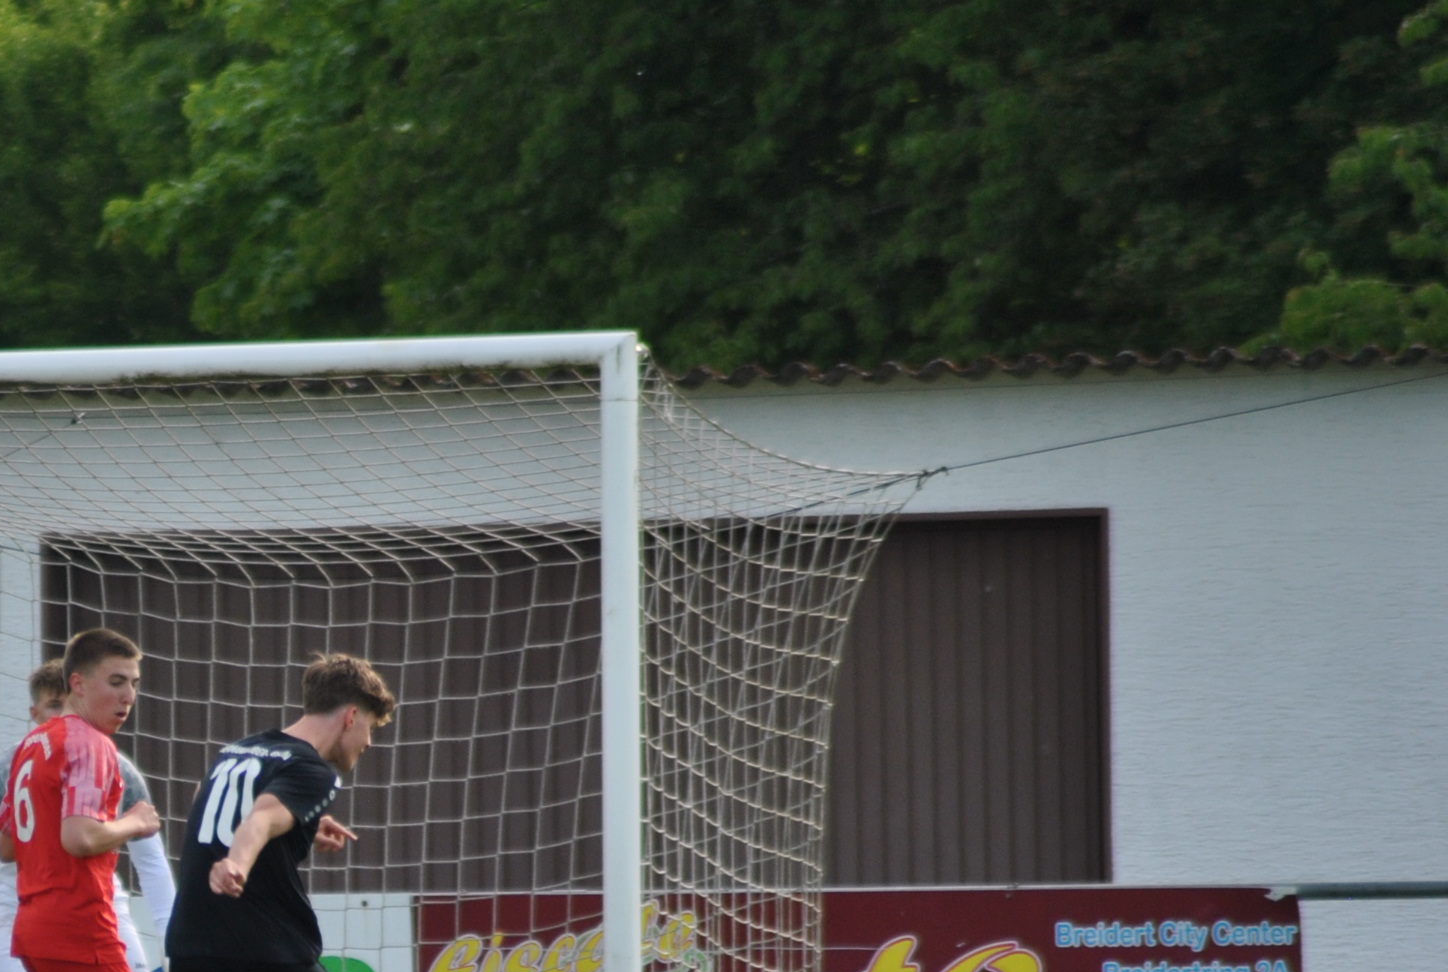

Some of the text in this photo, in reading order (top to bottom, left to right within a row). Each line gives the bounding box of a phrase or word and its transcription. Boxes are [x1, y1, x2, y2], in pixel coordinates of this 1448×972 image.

[14, 760, 35, 842] 6
[198, 758, 261, 848] 10
[1055, 921, 1297, 951] Breidert City Center
